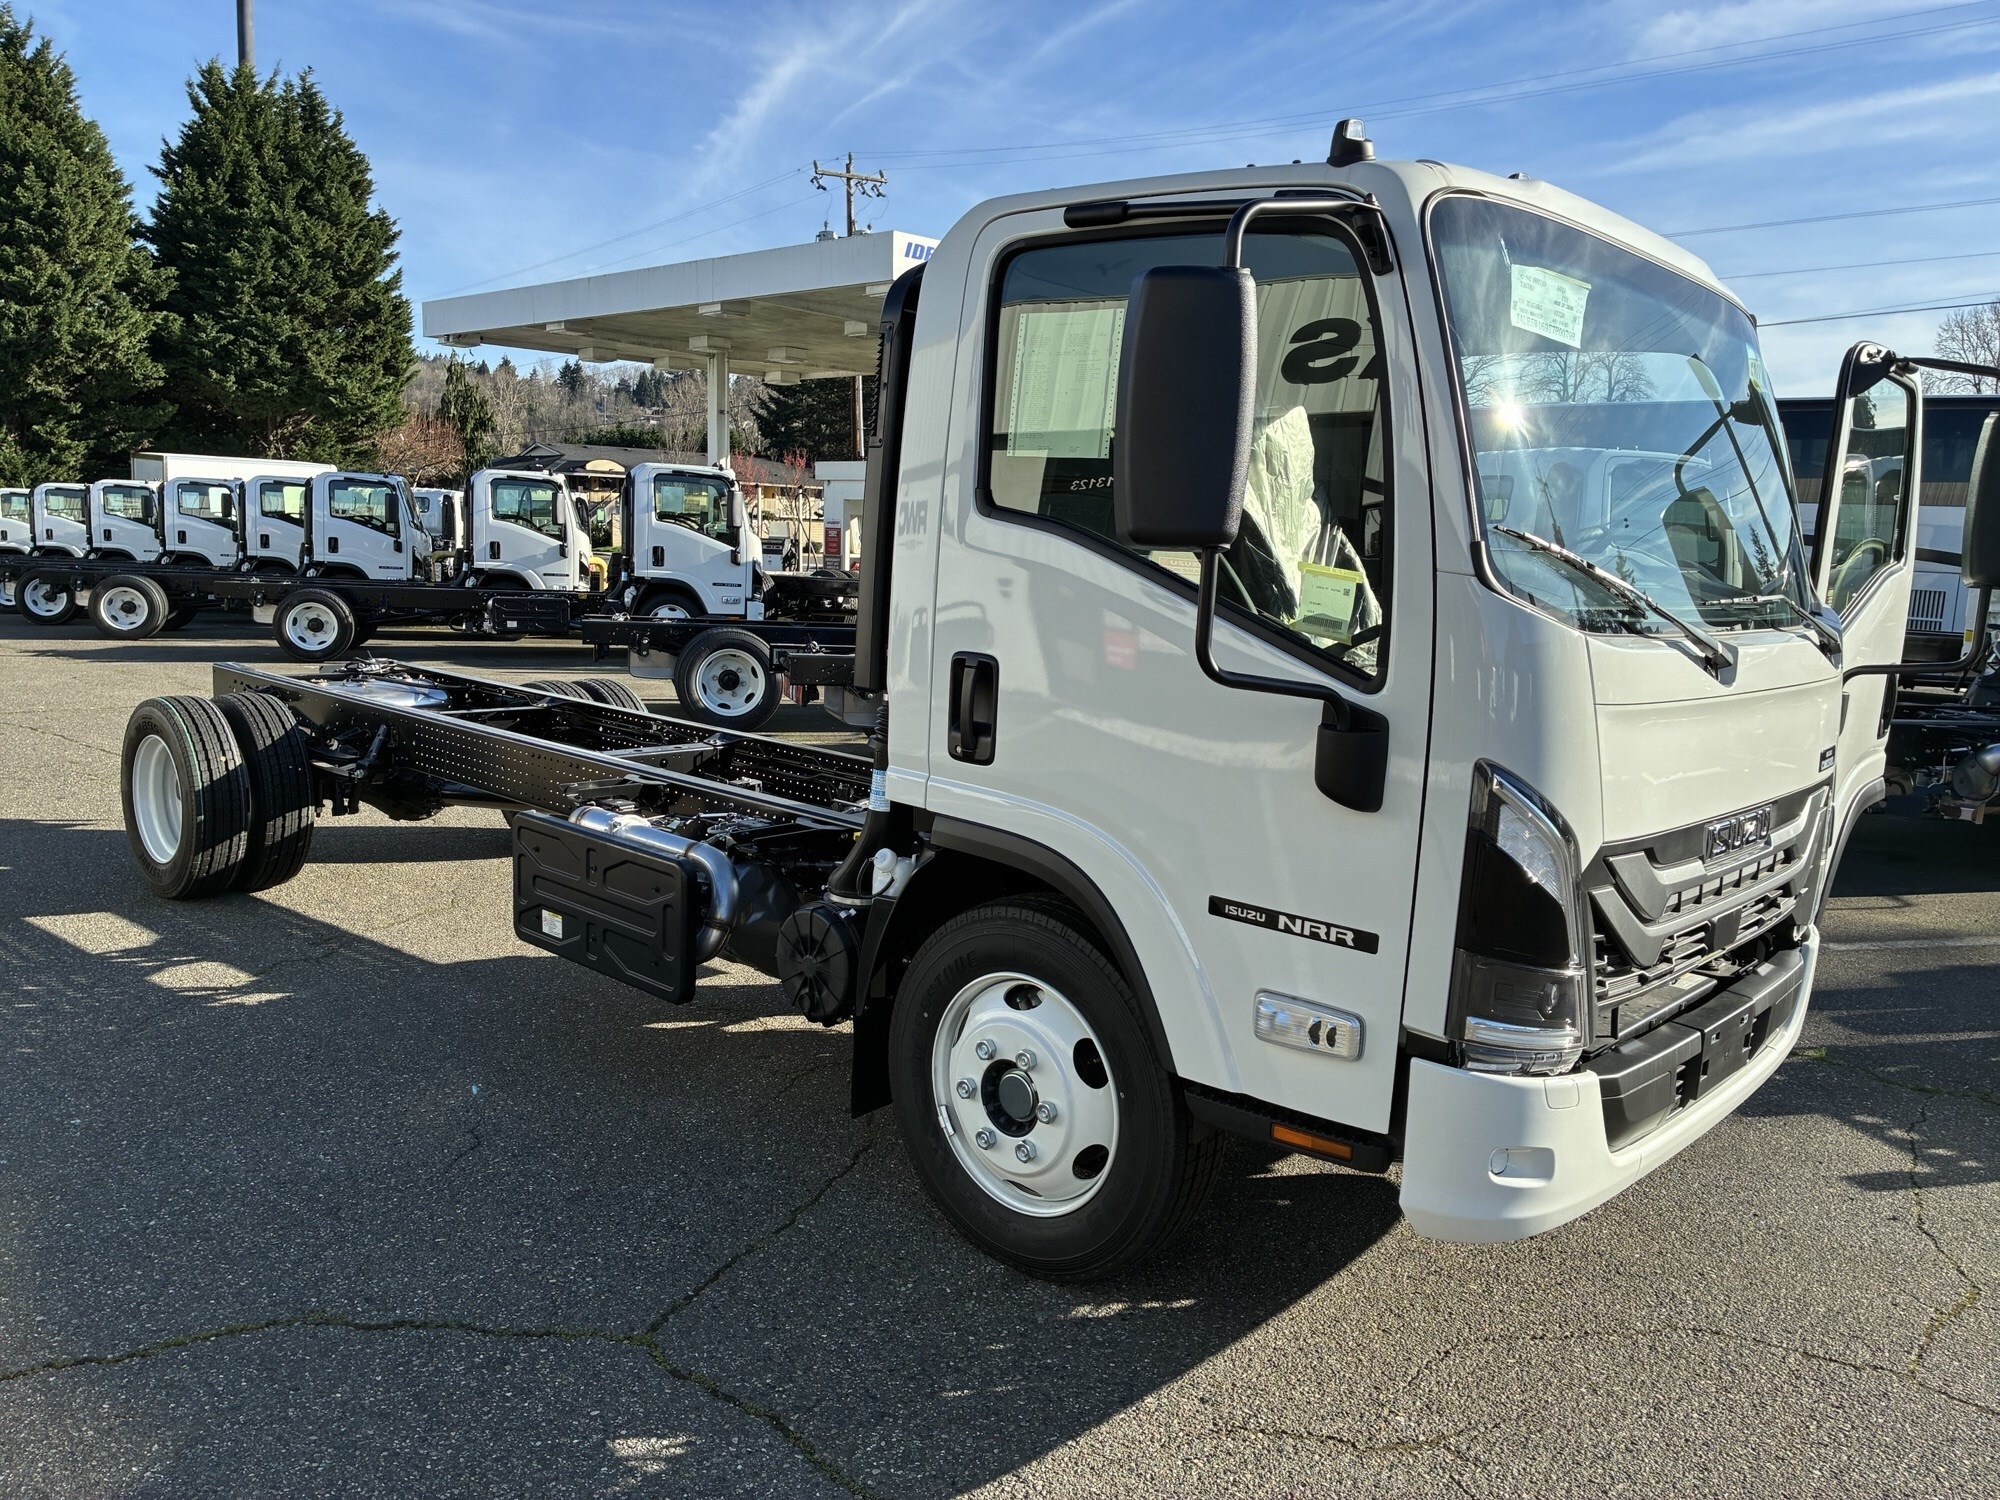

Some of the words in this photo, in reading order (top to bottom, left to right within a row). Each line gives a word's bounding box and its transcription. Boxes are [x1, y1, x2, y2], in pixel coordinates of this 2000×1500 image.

[1705, 806, 1772, 860] ISUZU
[1224, 904, 1266, 922] ISUZU
[1277, 914, 1356, 947] NRR
